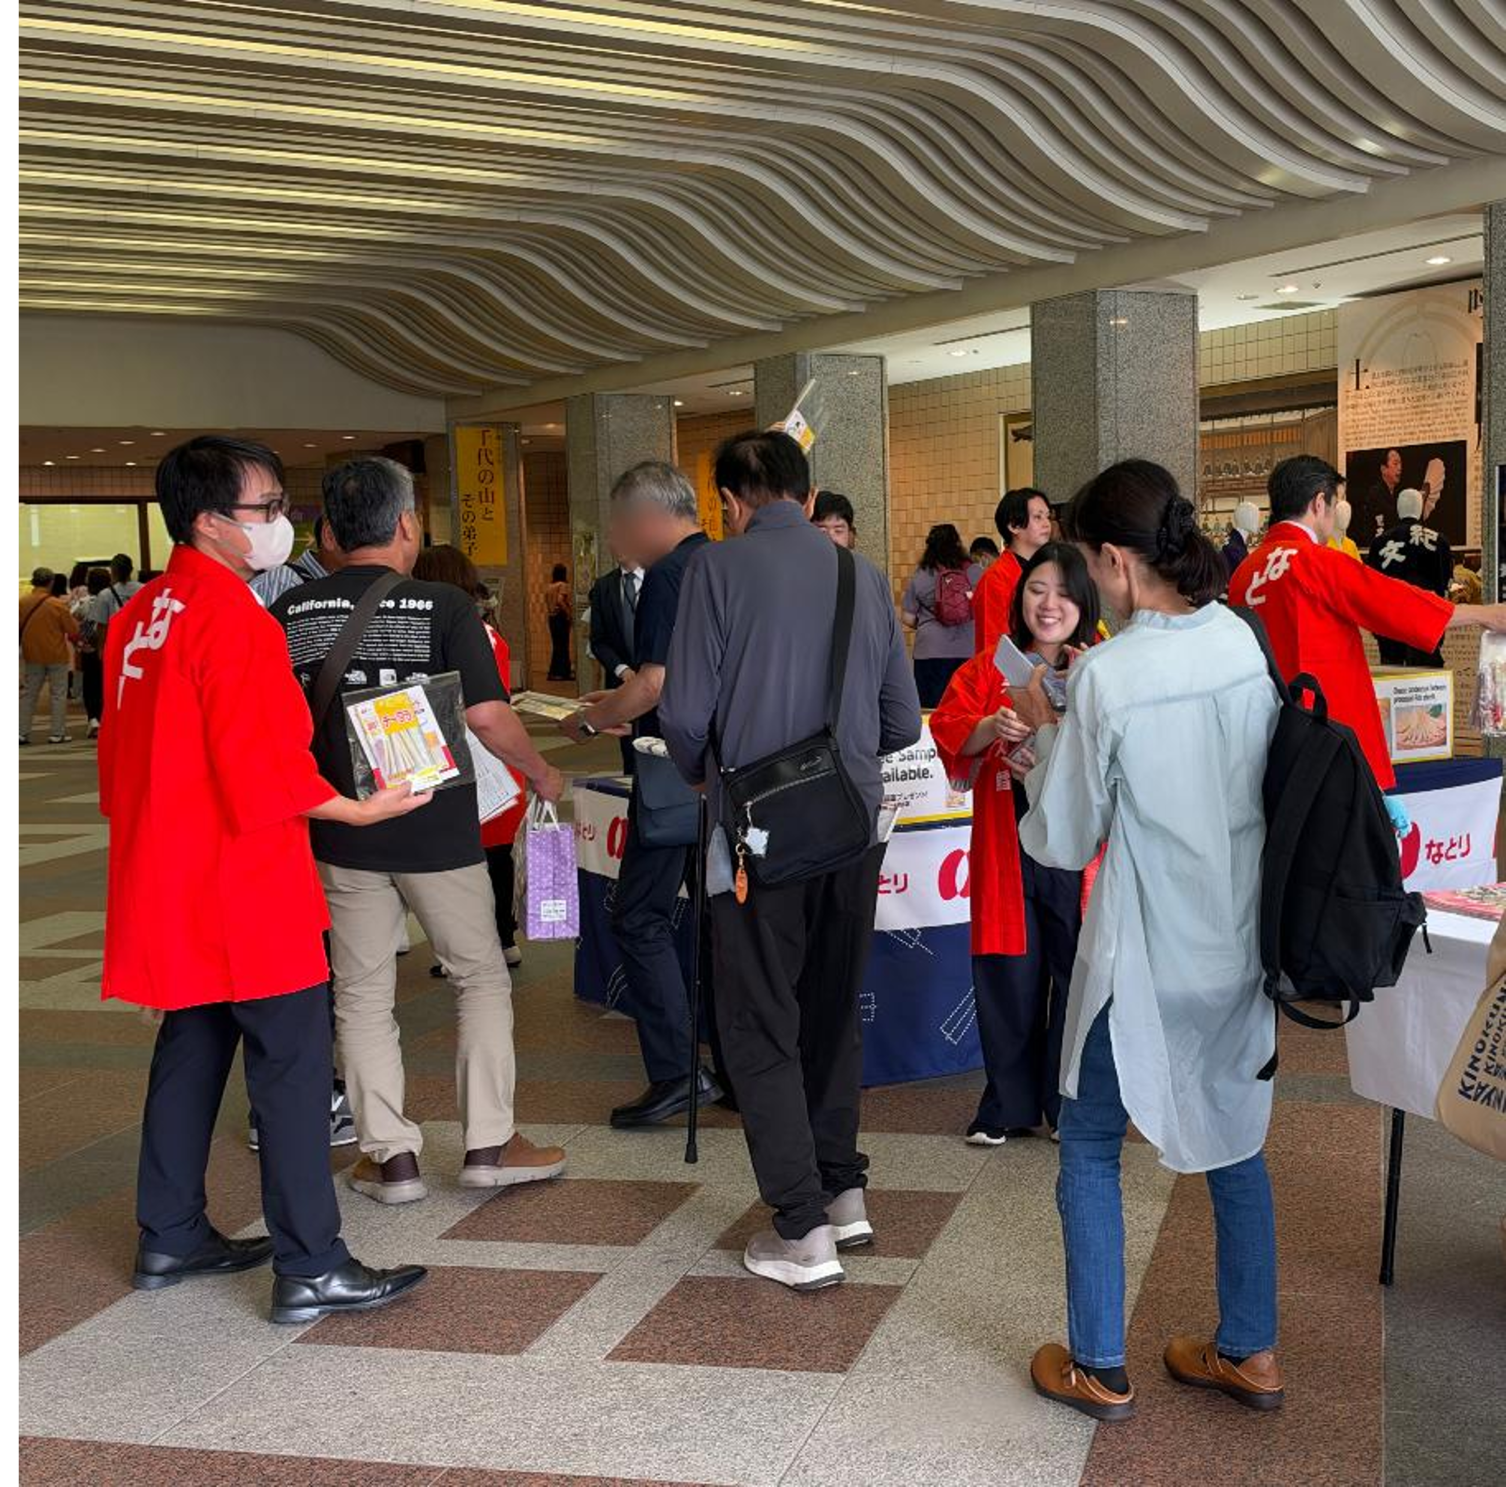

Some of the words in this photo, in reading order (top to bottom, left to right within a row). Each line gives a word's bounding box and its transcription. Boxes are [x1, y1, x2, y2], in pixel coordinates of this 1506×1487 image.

[1245, 546, 1298, 606] なと
[287, 597, 355, 615] California,
[899, 749, 936, 762] Samp
[883, 767, 934, 783] ailable.
[1425, 833, 1471, 864] なとり
[878, 873, 909, 894] とり
